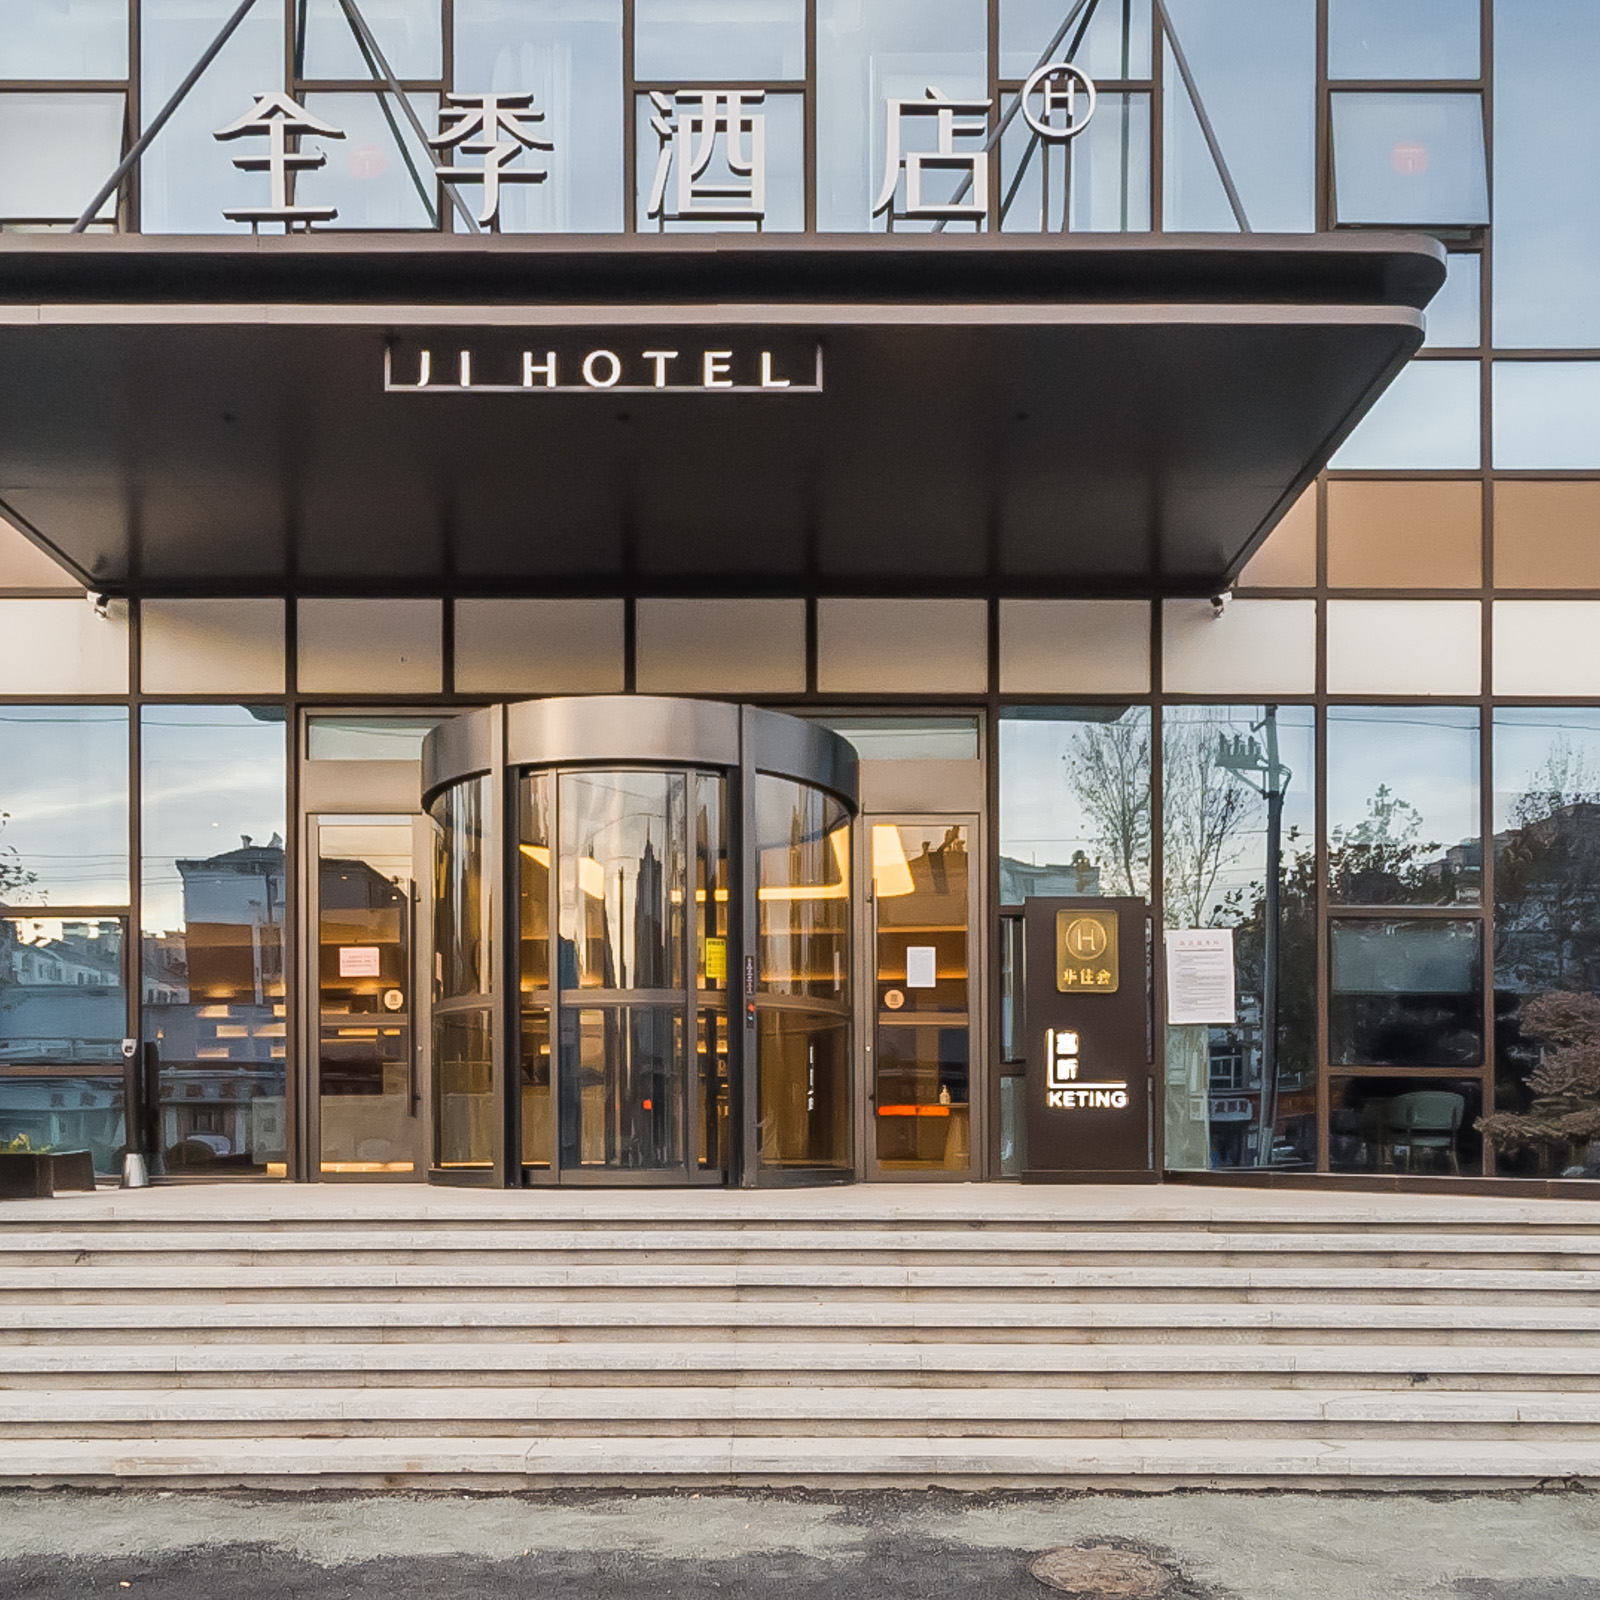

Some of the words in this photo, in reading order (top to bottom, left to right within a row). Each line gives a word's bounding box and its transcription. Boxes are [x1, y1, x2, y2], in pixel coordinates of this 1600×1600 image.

[212, 85, 994, 227] 全季酒店
[417, 349, 471, 388] JI
[522, 349, 791, 389] HOTEL
[1062, 967, 1112, 985] 华住会
[1048, 1089, 1129, 1109] KETING
